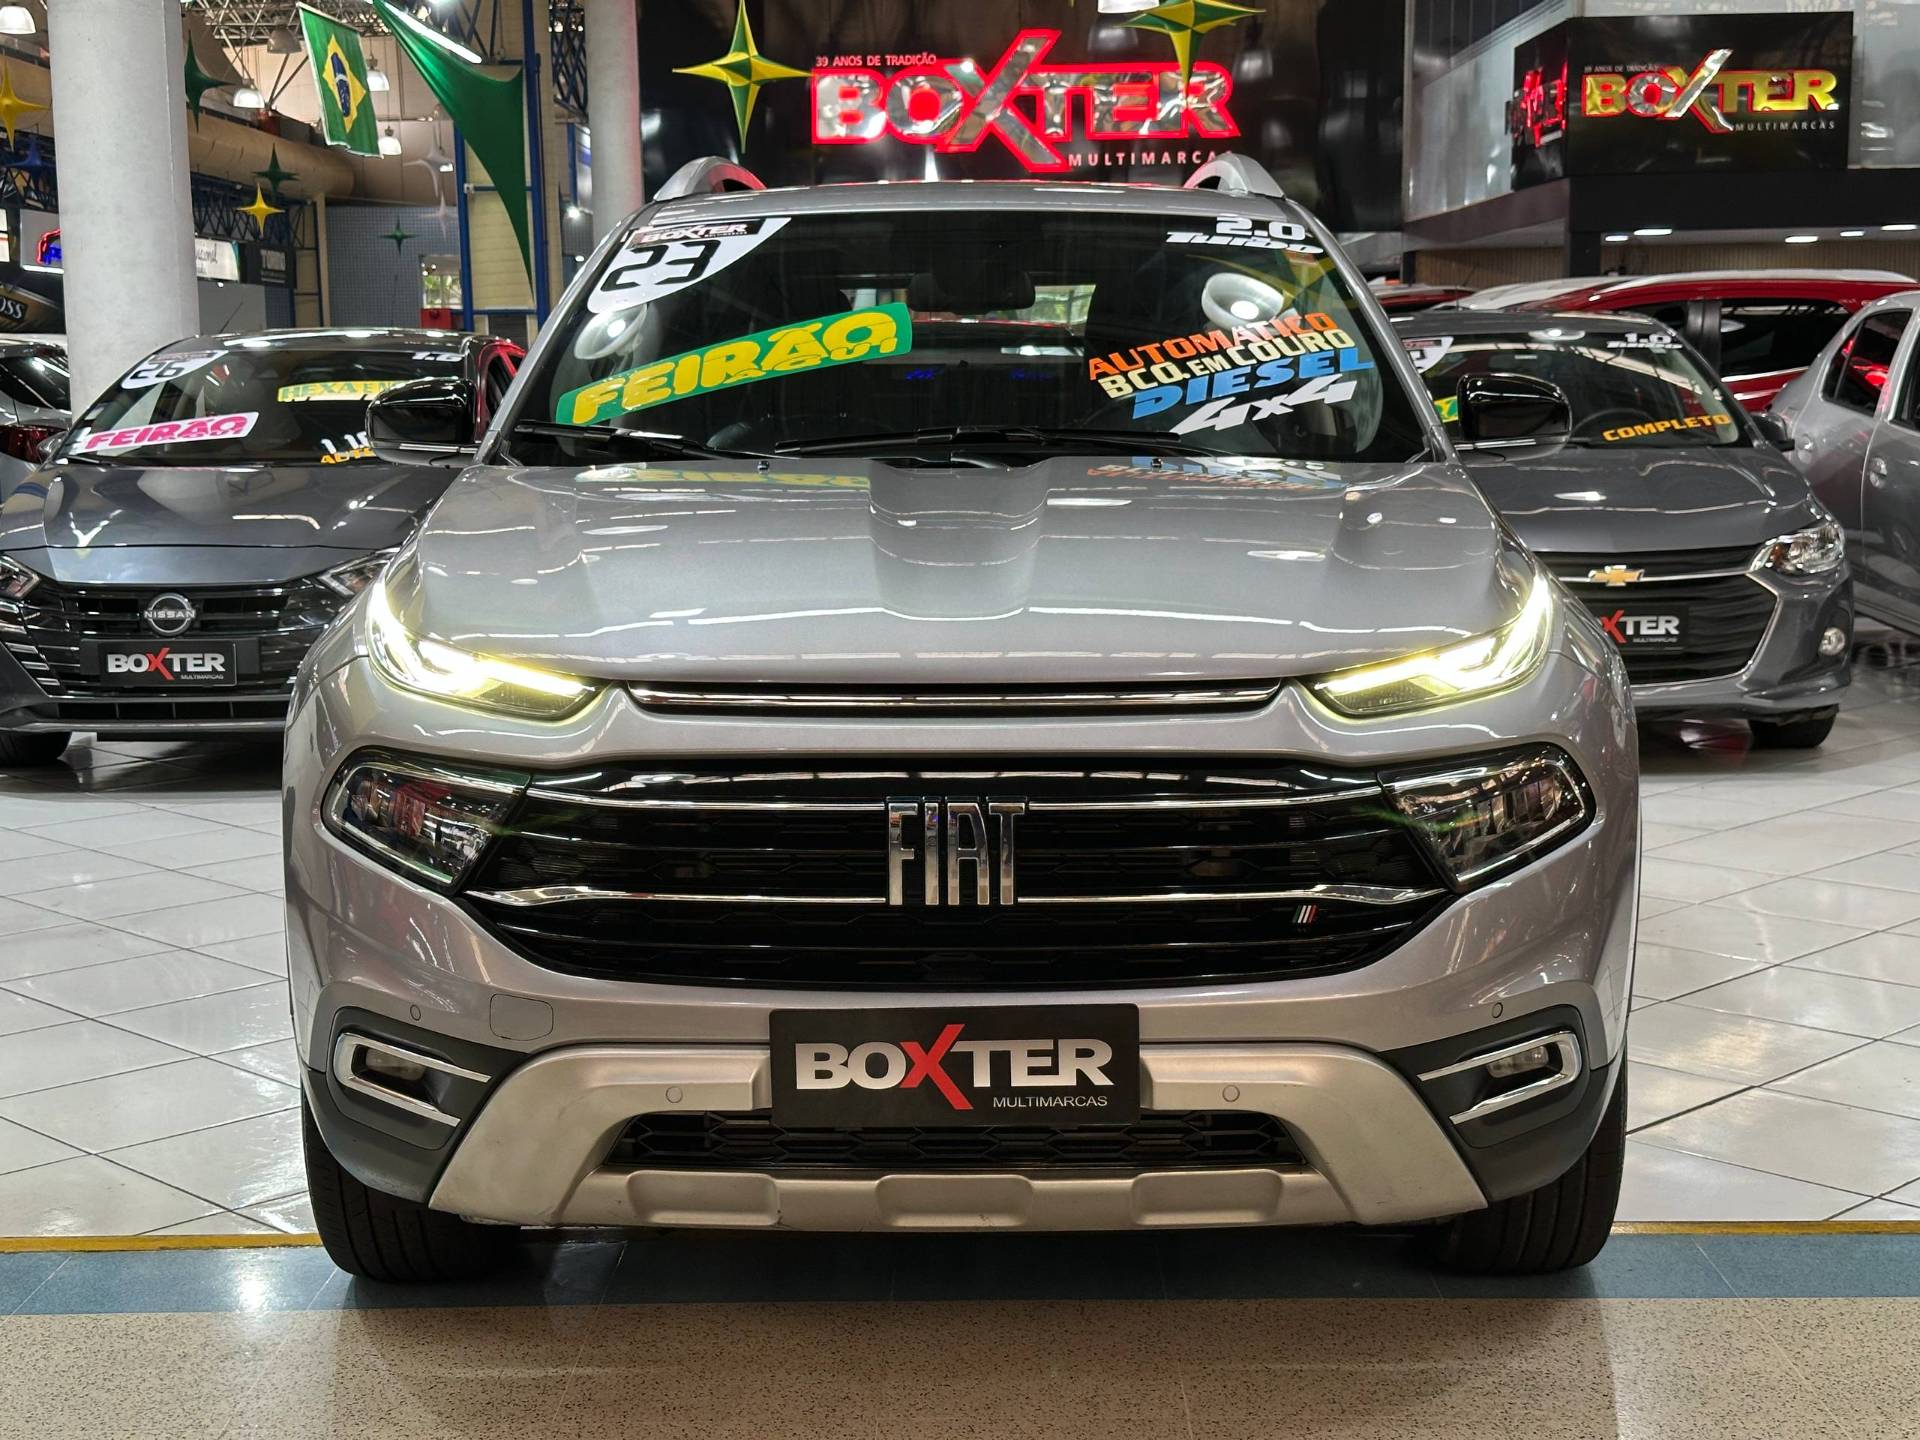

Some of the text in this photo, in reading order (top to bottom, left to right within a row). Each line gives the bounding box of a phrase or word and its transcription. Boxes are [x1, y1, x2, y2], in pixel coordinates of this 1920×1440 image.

[816, 52, 937, 66] 39 ANOS DE TRADIÇÃO
[812, 28, 1241, 172] BOXTER
[1581, 48, 1840, 134] BOXTER
[1068, 151, 1232, 166] MULTIMARCA
[1216, 213, 1306, 241] 2.0
[600, 239, 721, 292] 23
[573, 312, 897, 424] FEIRÃO
[1186, 354, 1230, 376] EM
[1227, 329, 1355, 366] COURO
[1132, 347, 1375, 419] DIESEL
[1602, 414, 1731, 441] COMPLETO
[144, 610, 196, 619] NISSAN
[107, 647, 225, 680] BOXTER
[887, 799, 1026, 905] FIAT
[795, 1024, 1114, 1110] BOXTER
[993, 1095, 1108, 1108] MULTIMARCAS
